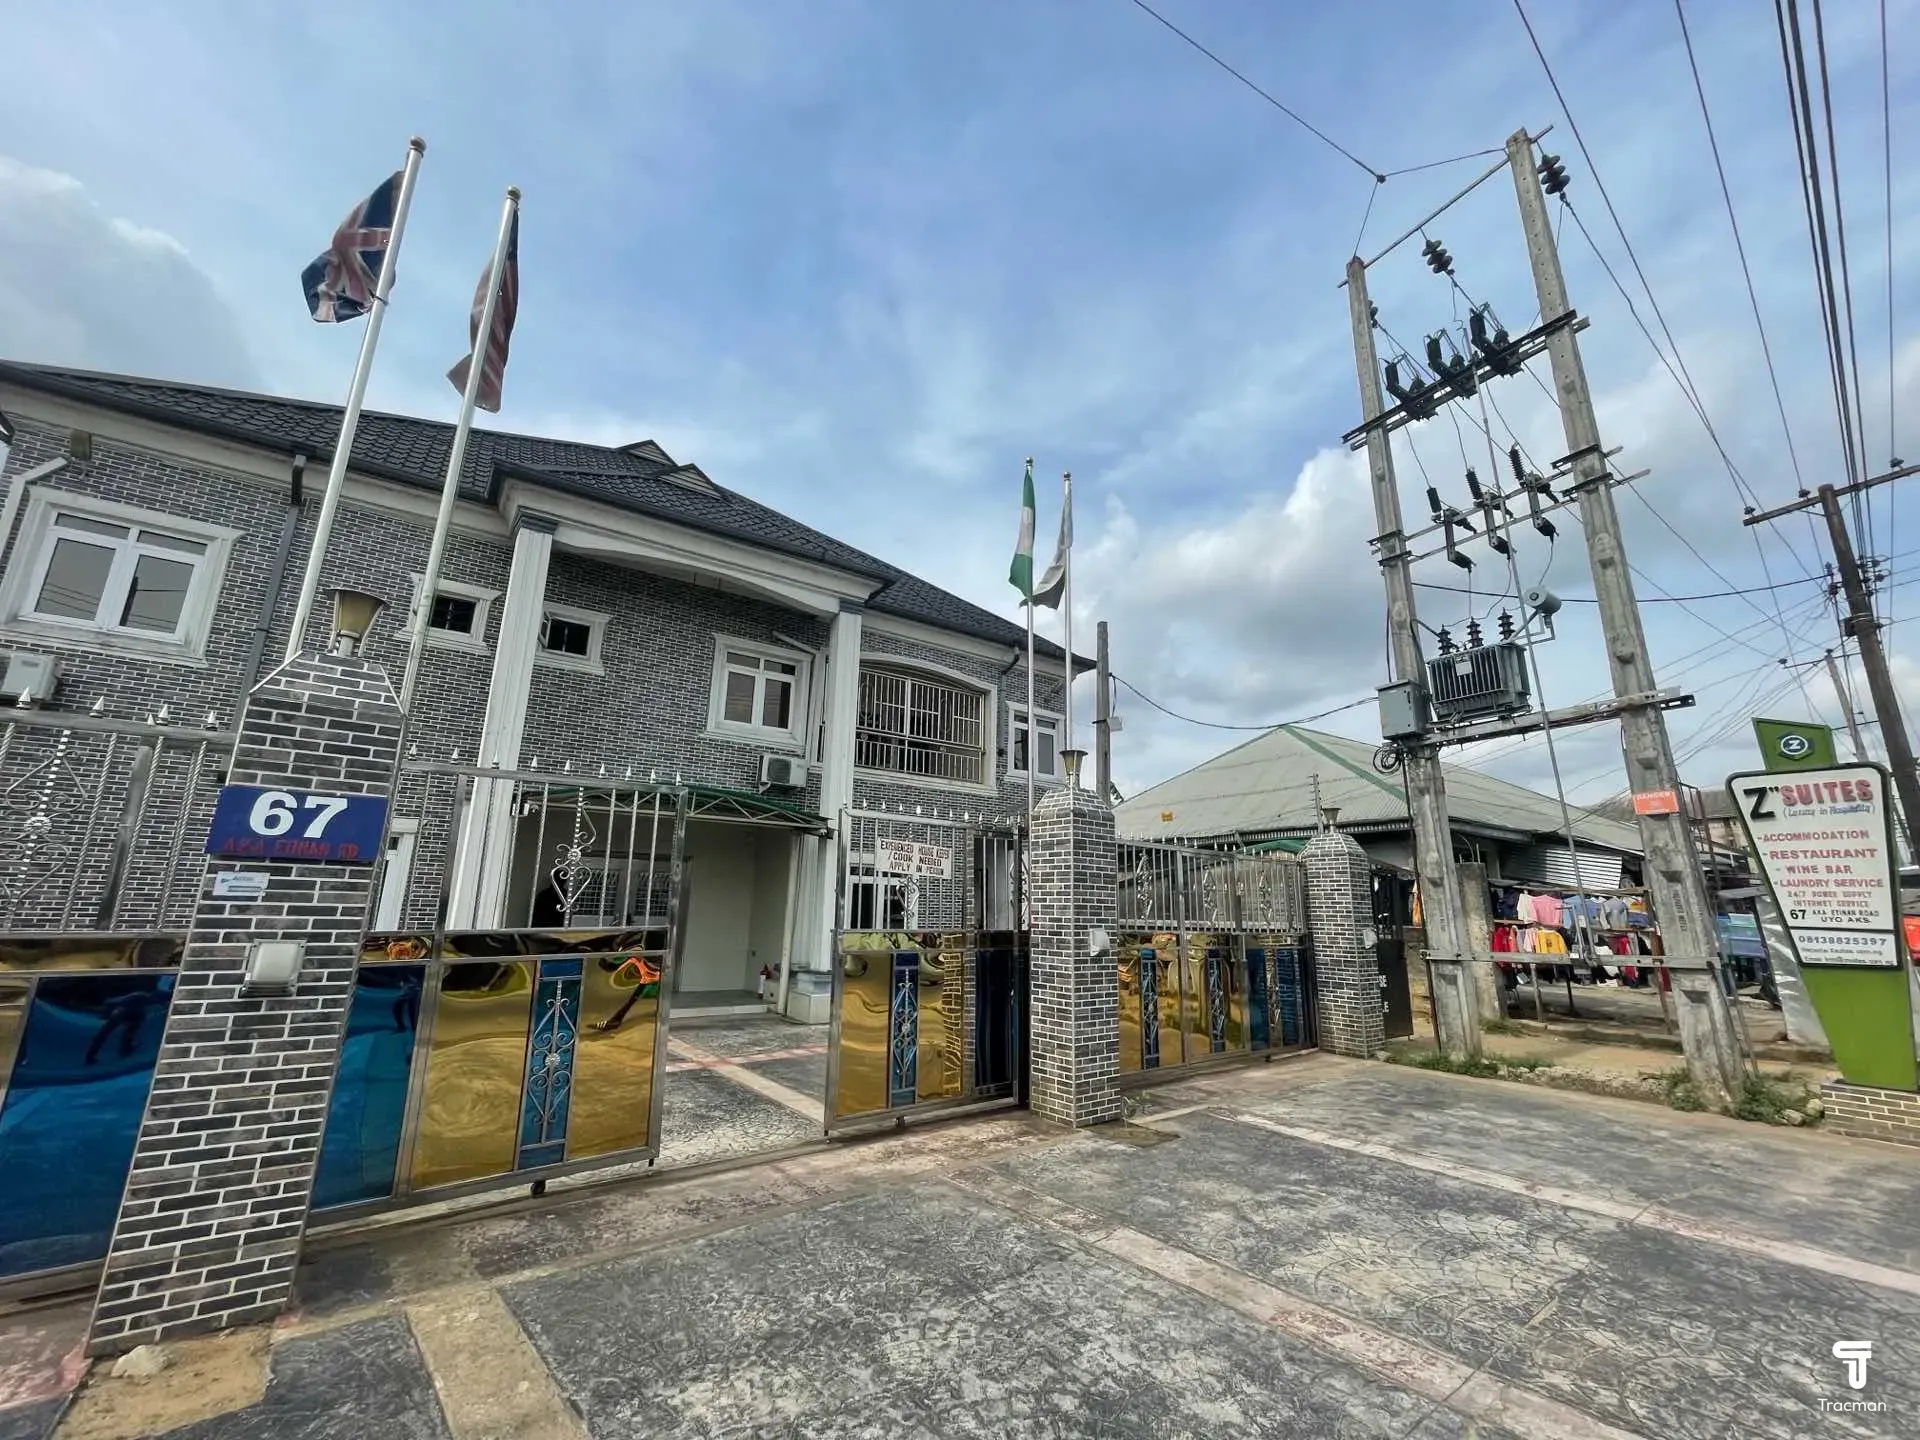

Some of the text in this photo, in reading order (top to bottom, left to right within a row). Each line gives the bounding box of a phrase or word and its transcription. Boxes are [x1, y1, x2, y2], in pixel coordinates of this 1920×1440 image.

[250, 790, 348, 838] 67
[889, 860, 911, 872] APPLY
[916, 864, 923, 873] IN
[919, 856, 942, 867] NEEDED
[1785, 865, 1853, 874] WINE BAR
[1834, 879, 1884, 888] SERVICE
[1790, 909, 1806, 920] 67
